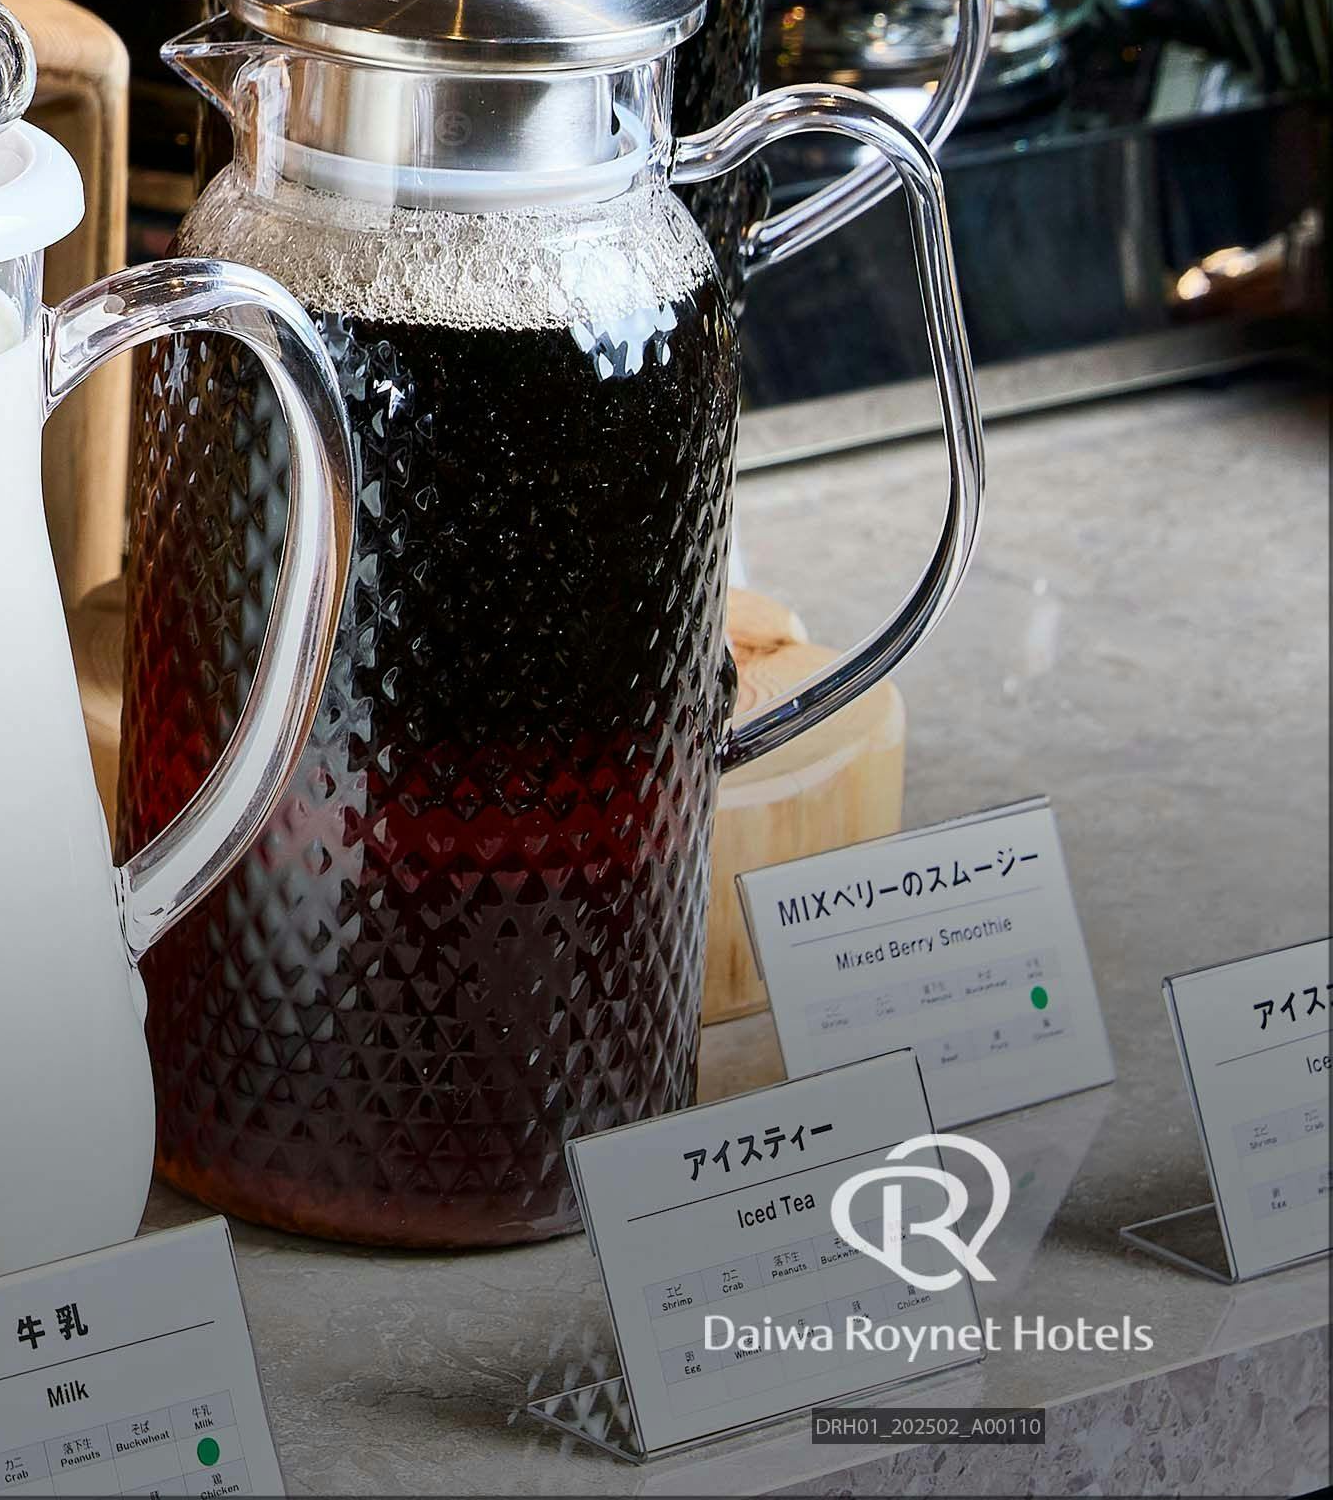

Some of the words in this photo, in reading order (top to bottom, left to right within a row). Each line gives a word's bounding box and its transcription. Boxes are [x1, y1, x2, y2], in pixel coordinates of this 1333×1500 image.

[778, 847, 1039, 927] MIXベリーのスムージー
[836, 947, 884, 971] Mixed
[889, 935, 934, 960] Berry
[939, 916, 1012, 946] Smoothie
[1254, 984, 1333, 1030] アイス
[683, 1122, 834, 1181] アイスティー
[737, 1200, 777, 1229] Iced
[780, 1192, 816, 1217] Tea
[661, 1295, 693, 1312] Shrimp
[721, 1280, 744, 1294] Crab
[771, 1263, 808, 1279] Peanuts
[17, 1303, 89, 1350] 牛乳
[47, 1380, 90, 1409] Milk
[4, 1470, 29, 1484] Crab
[60, 1449, 101, 1468] Peanuts
[115, 1430, 171, 1453] Buckwheat
[194, 1418, 214, 1431] Milk
[200, 1483, 240, 1500] Chicken
